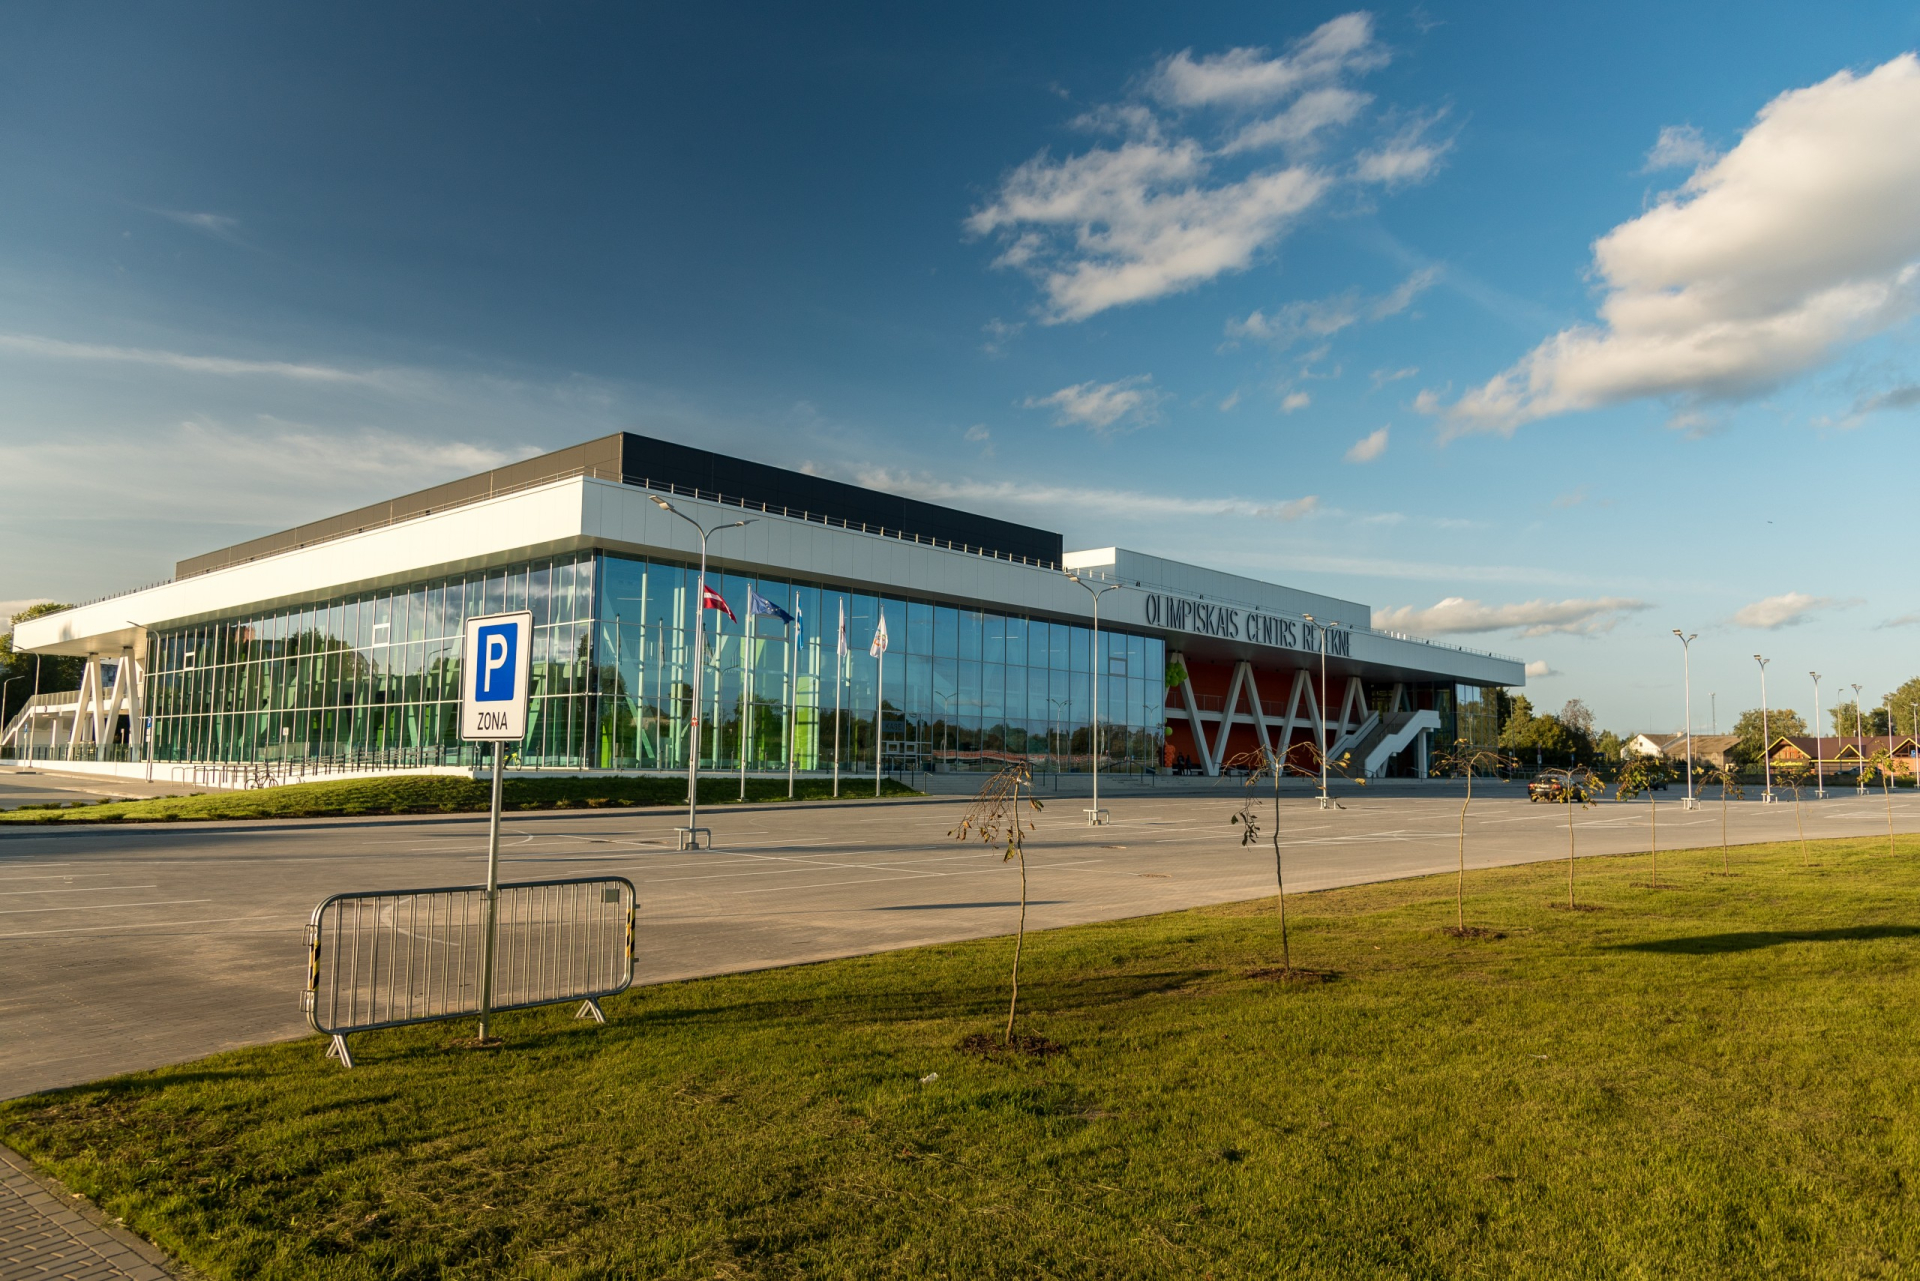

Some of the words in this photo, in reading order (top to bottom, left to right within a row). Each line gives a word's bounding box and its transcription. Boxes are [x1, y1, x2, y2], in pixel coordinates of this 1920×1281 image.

[1146, 593, 1239, 639] OLIMPISKAIS
[1246, 612, 1297, 648] CENTRS
[483, 633, 508, 692] P
[477, 711, 508, 731] ZONA
